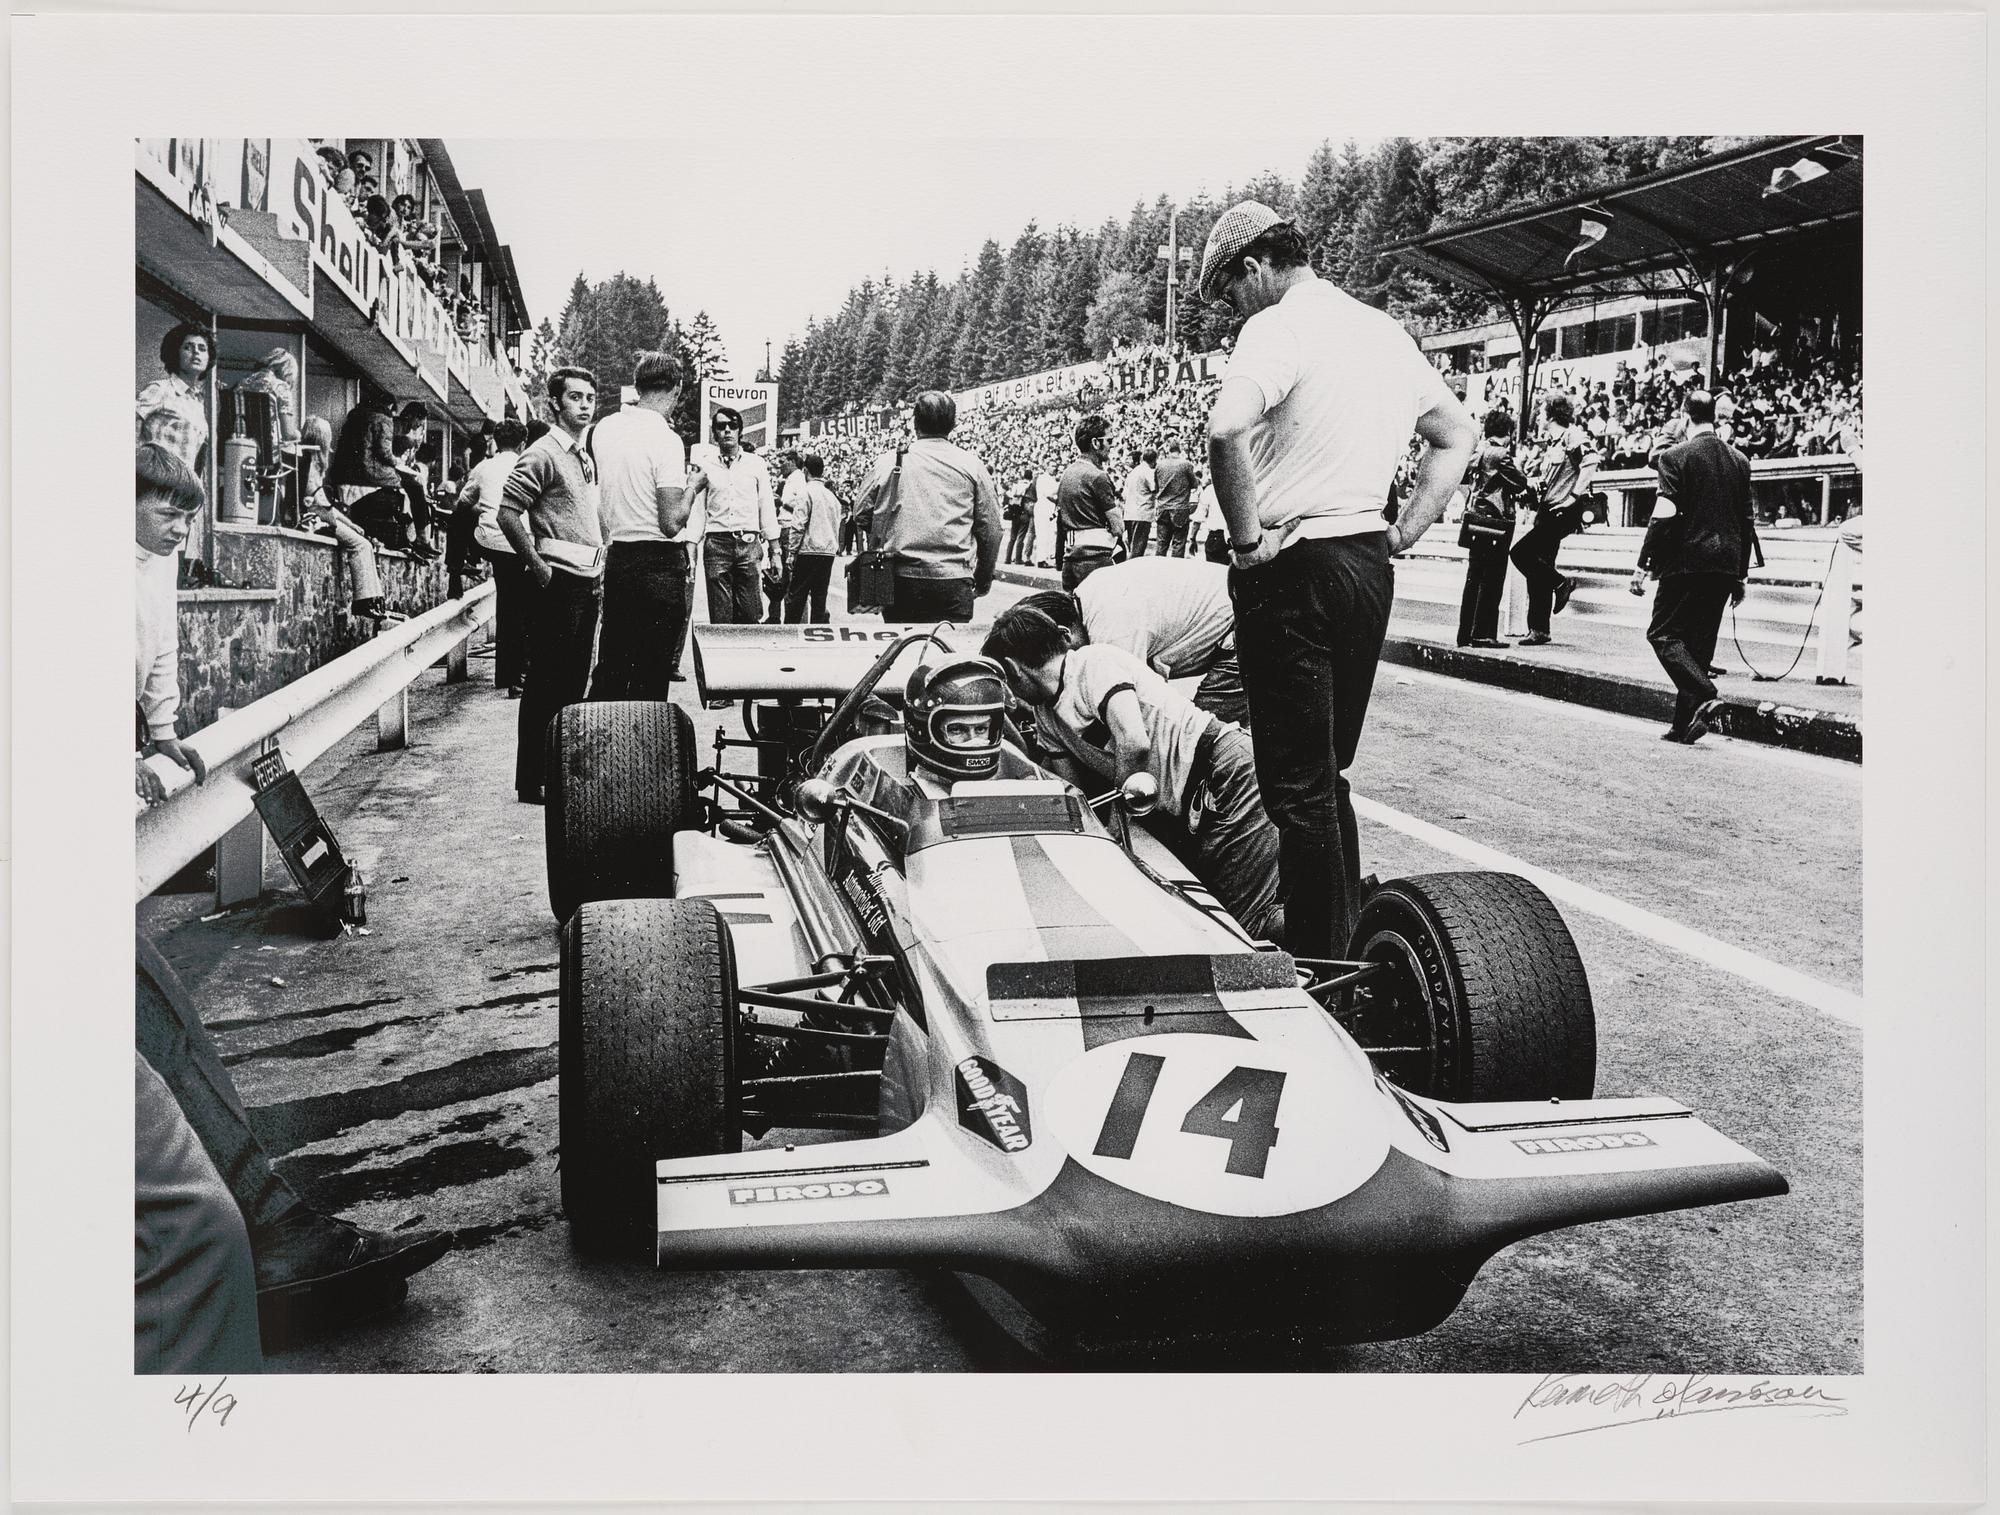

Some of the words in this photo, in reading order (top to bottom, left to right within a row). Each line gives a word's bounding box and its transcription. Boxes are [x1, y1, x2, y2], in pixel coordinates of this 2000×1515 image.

[292, 158, 369, 302] Shell
[709, 385, 768, 400] Chevron
[984, 386, 1000, 405] elf
[1015, 379, 1031, 399] elf
[1046, 371, 1062, 392] elf
[1488, 367, 1574, 395] YARLEY
[1092, 1052, 1287, 1179] 14
[1516, 1133, 1650, 1153] FERODO
[734, 1180, 884, 1203] FERODO
[174, 1375, 238, 1433] 4/9
